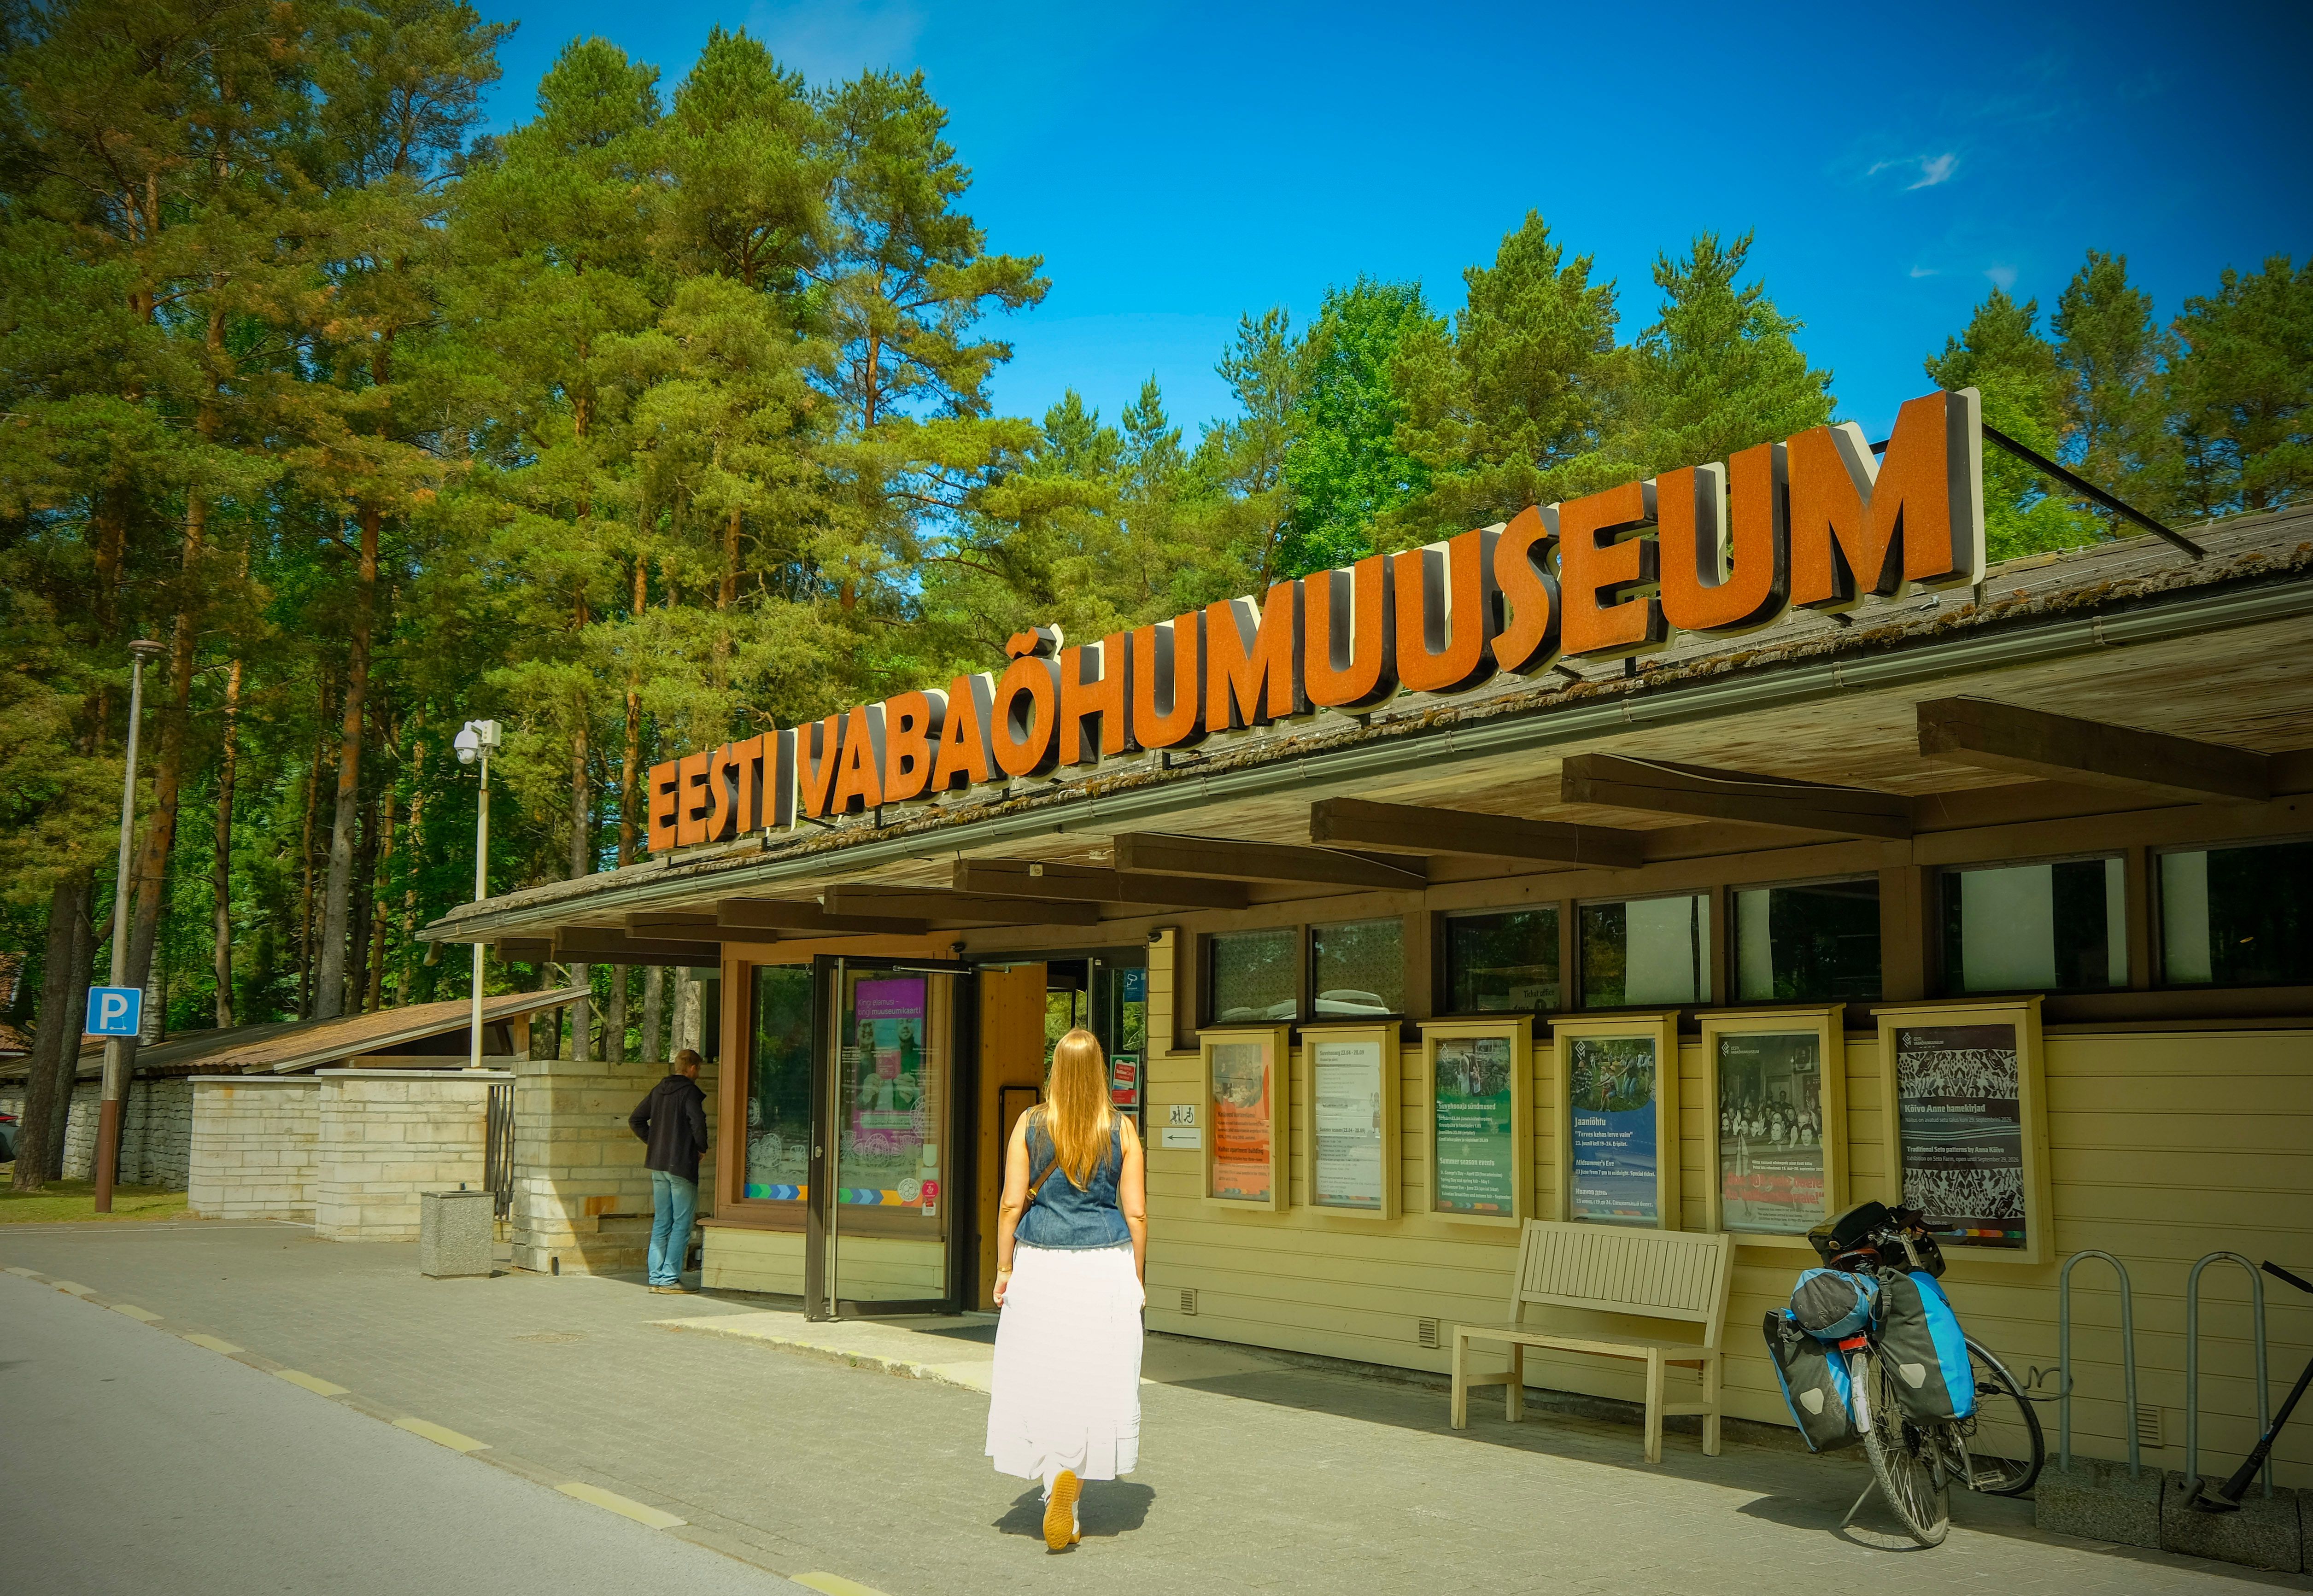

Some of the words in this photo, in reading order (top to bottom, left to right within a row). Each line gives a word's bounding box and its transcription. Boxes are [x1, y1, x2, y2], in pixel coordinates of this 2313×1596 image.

[648, 730, 795, 853] EESTI
[797, 389, 1973, 819] VABAÕHUMUUSEUM
[858, 999, 871, 1007] Kingi
[100, 993, 128, 1029] P
[1947, 1104, 1985, 1113] hamekirjad
[1575, 1117, 1606, 1127] Jaaniõhtu
